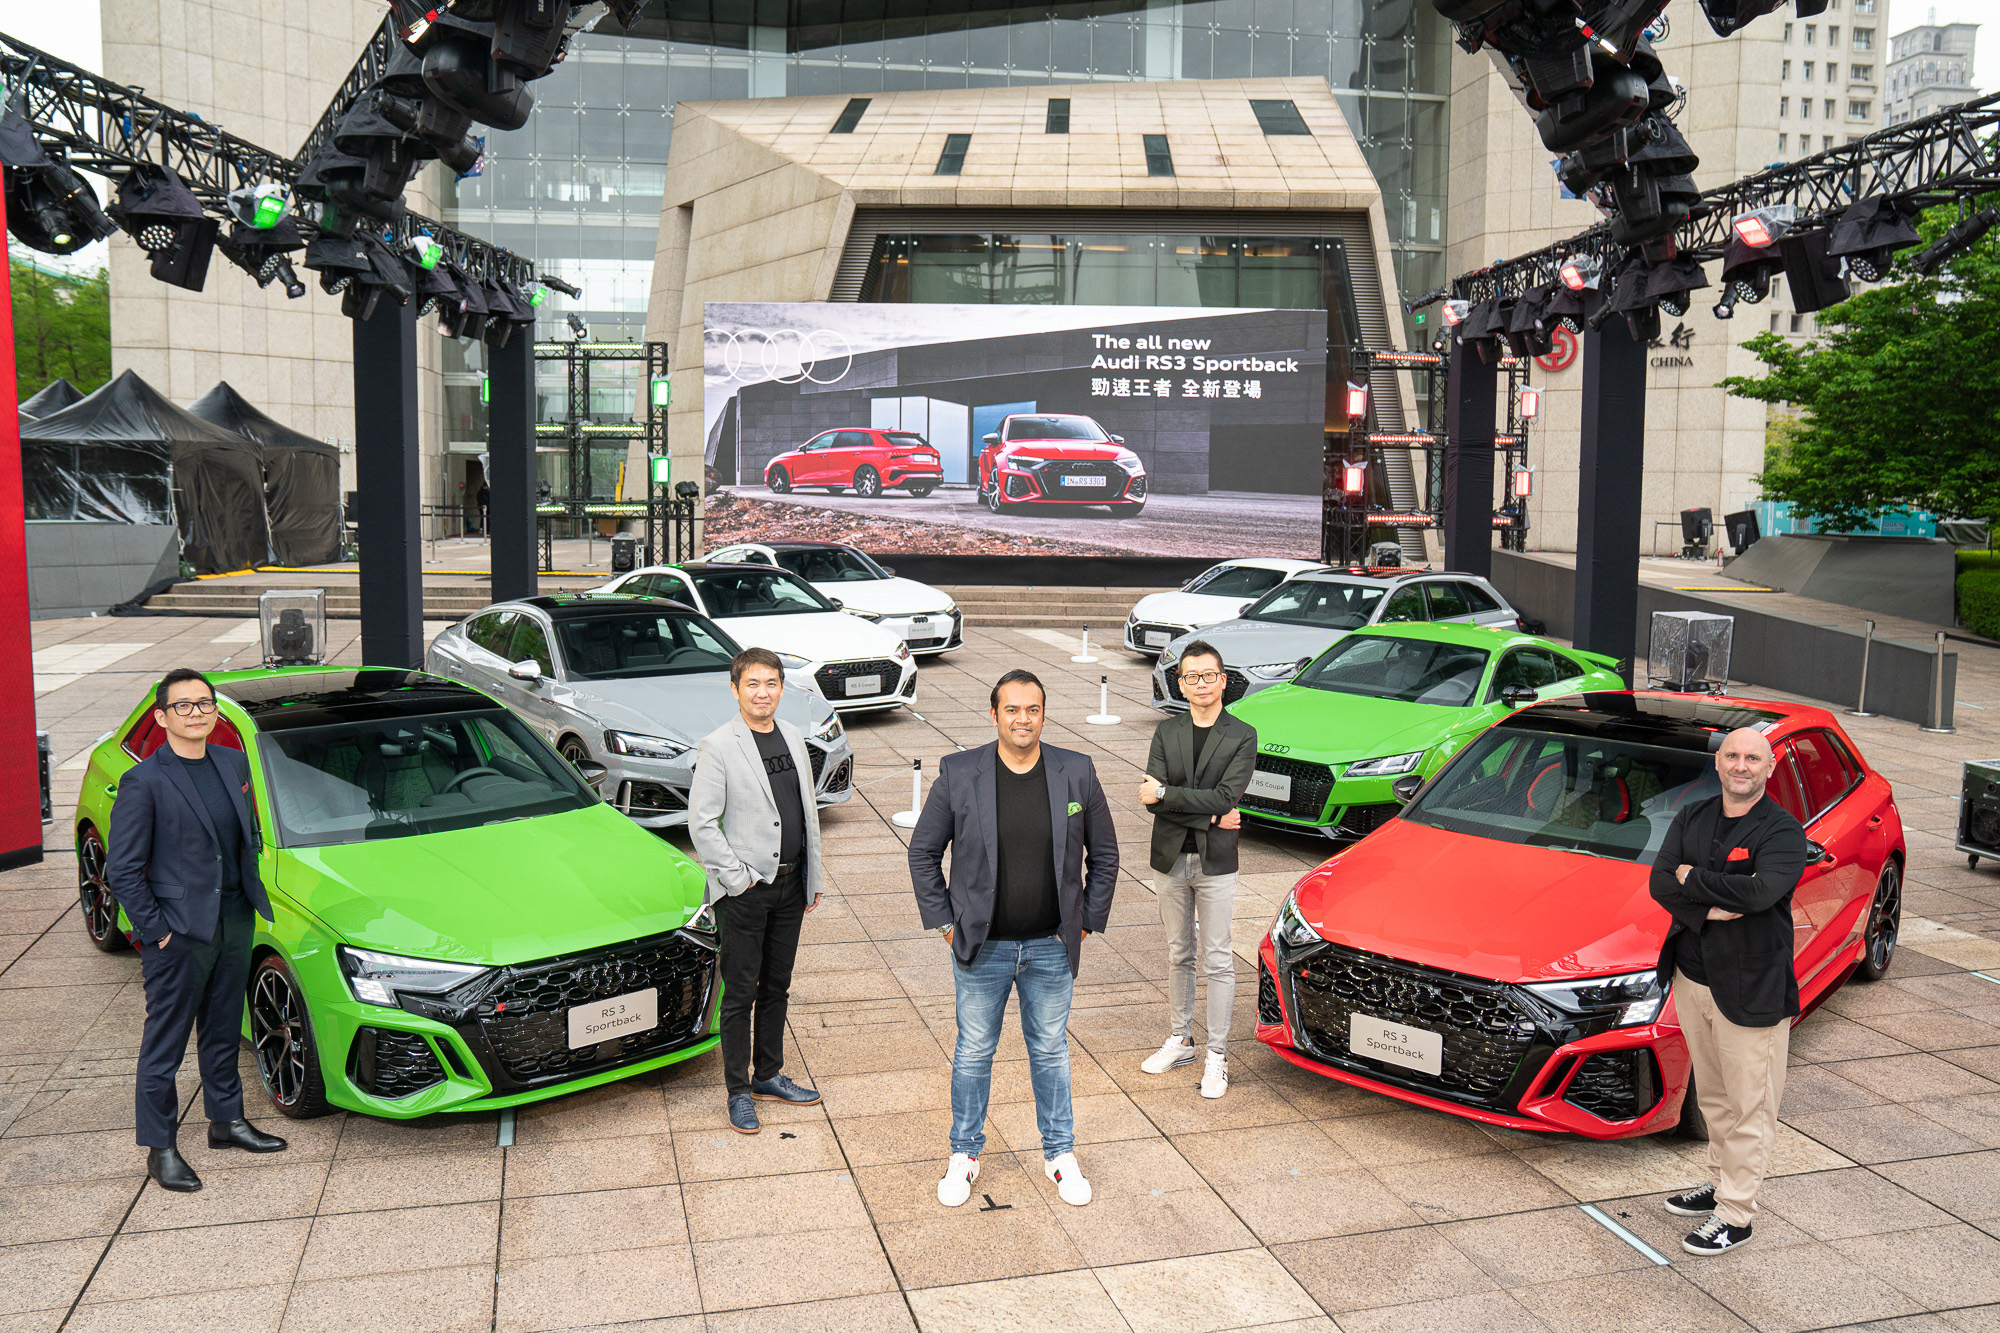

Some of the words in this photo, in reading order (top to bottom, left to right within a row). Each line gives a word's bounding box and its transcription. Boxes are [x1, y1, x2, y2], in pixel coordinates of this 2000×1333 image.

[1091, 334, 1131, 350] The
[1135, 335, 1163, 350] all
[1167, 338, 1211, 350] new
[1091, 354, 1140, 370] Audi
[1146, 355, 1186, 371] RS3
[1192, 356, 1299, 374] Sportback
[1650, 356, 1694, 367] CHINA
[1091, 377, 1172, 398] 勁速王者
[1181, 378, 1262, 399] 全新登場
[1265, 781, 1285, 790] Coupé
[601, 1007, 616, 1018] RS
[619, 1005, 626, 1014] 3
[585, 1013, 642, 1034] Sportback
[1383, 1029, 1398, 1041] RS
[1401, 1034, 1408, 1044] 3
[1366, 1037, 1424, 1060] Sportback
